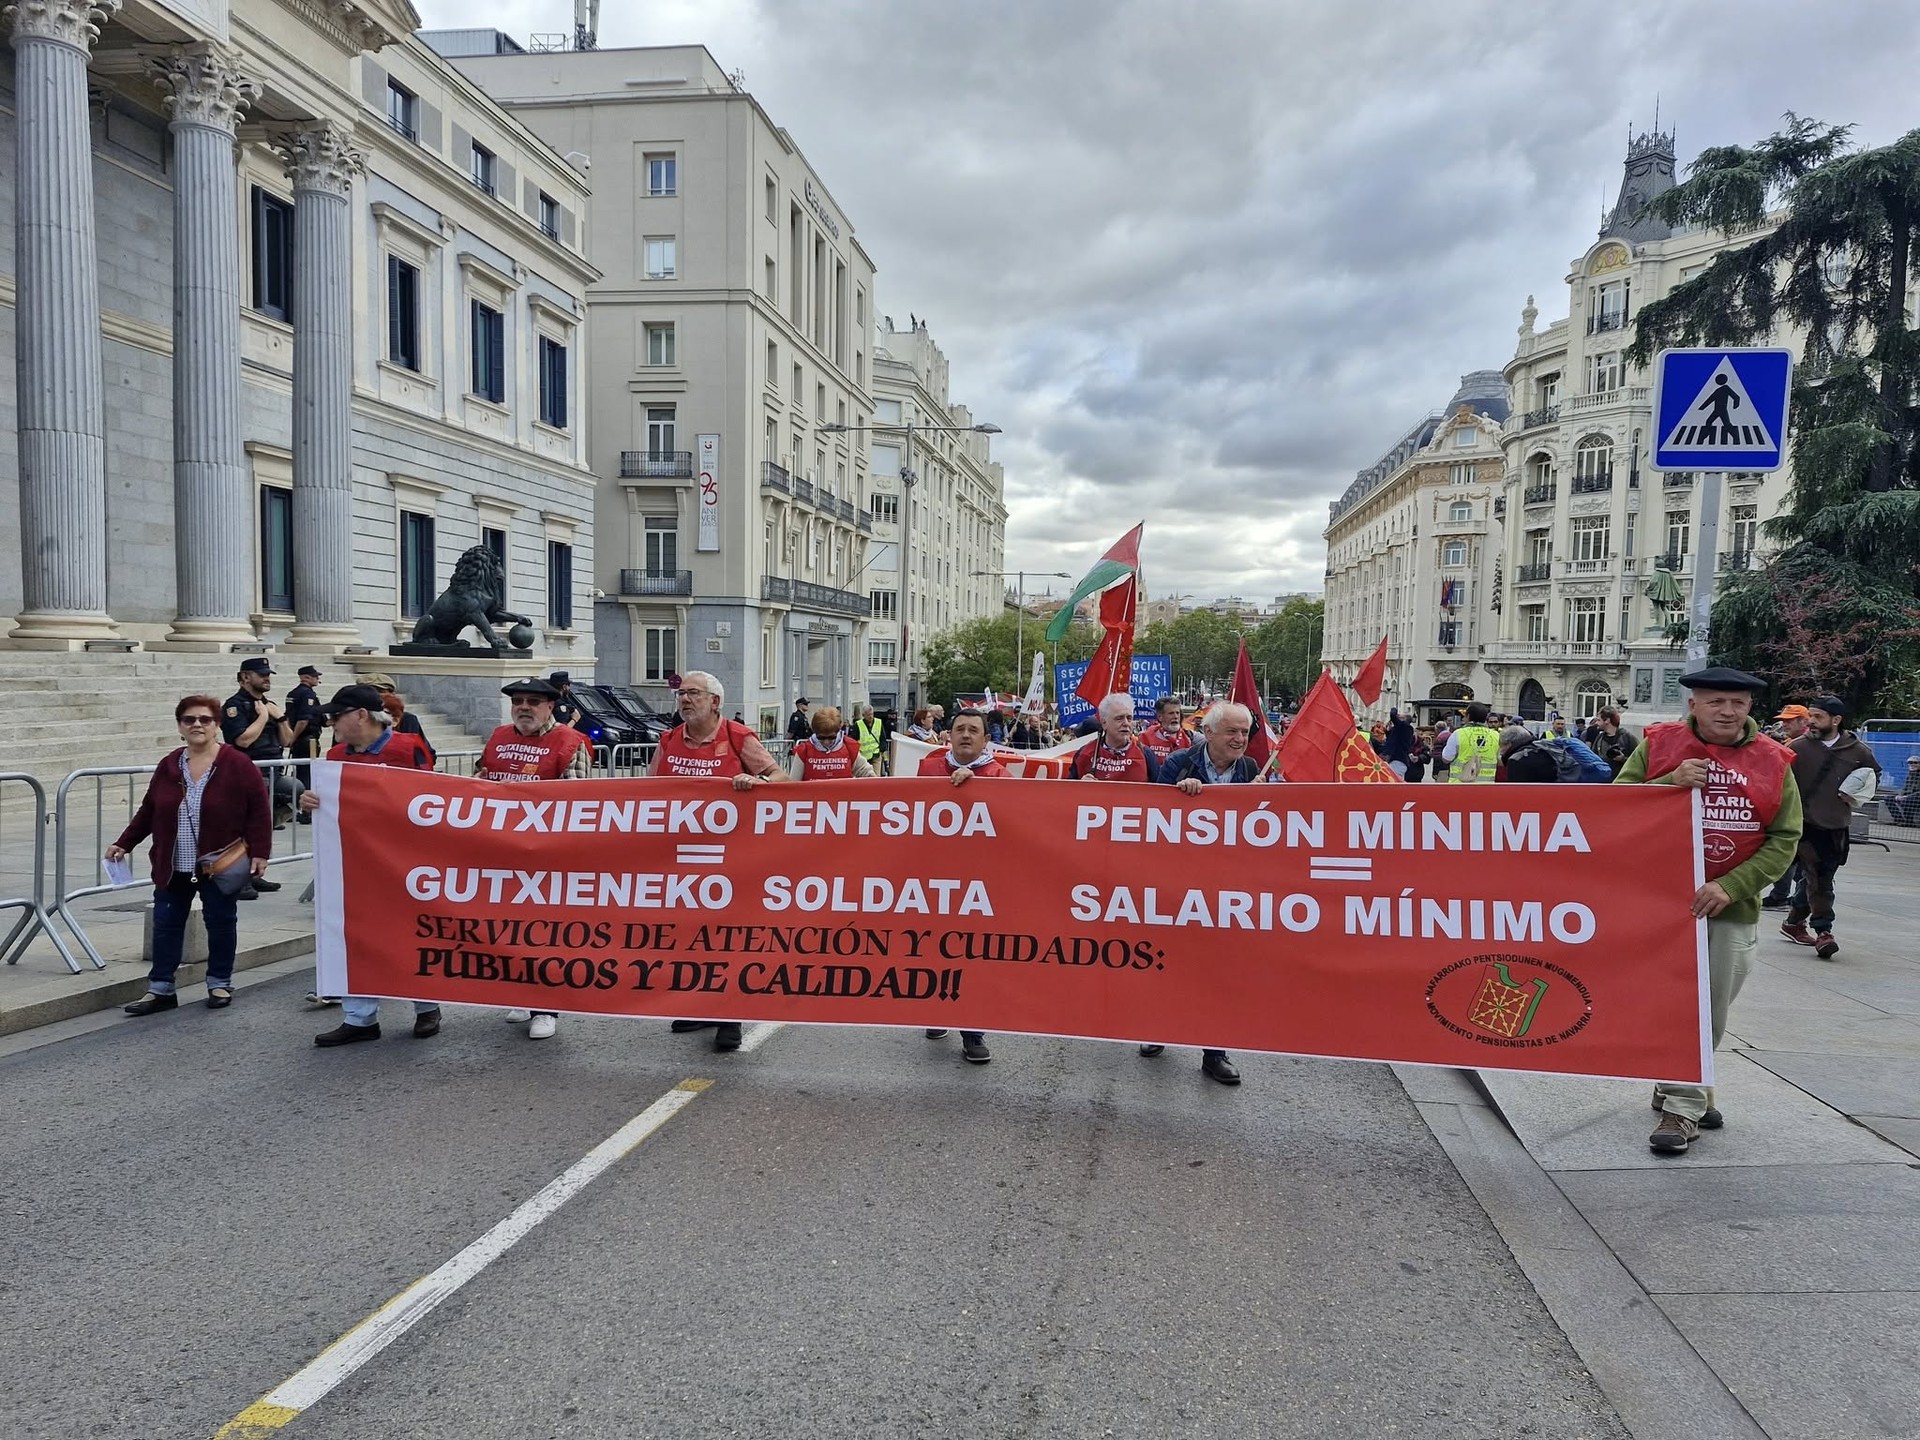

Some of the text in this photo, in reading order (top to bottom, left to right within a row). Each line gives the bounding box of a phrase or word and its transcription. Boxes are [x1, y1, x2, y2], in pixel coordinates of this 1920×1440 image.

[701, 472, 717, 505] 95
[496, 744, 550, 755] GUTXIENEKO
[488, 772, 540, 781] GUTXIENEKO
[407, 794, 996, 837] GUTXIENEKO PENTSIOA
[1076, 801, 1591, 852] PENSIÓN MÍNIMA
[1702, 805, 1752, 821] ÍNIMO
[406, 866, 994, 917] GUTXIENEKO SOLDATA
[1070, 884, 1596, 944] SALARIO MÍNIMO
[416, 914, 1166, 971] SERVICIOS DE ATENCIÓN Y CUIDADOS:
[415, 944, 963, 1001] PÚBLICOS Y DE CALIDAD!!
[1425, 953, 1592, 1006] NAFARROAKO PENTSIODUNEN MUGIMENDUA
[1426, 1002, 1592, 1048] MOVIMIENTO PENSIONISTAS DE NAVARRA
